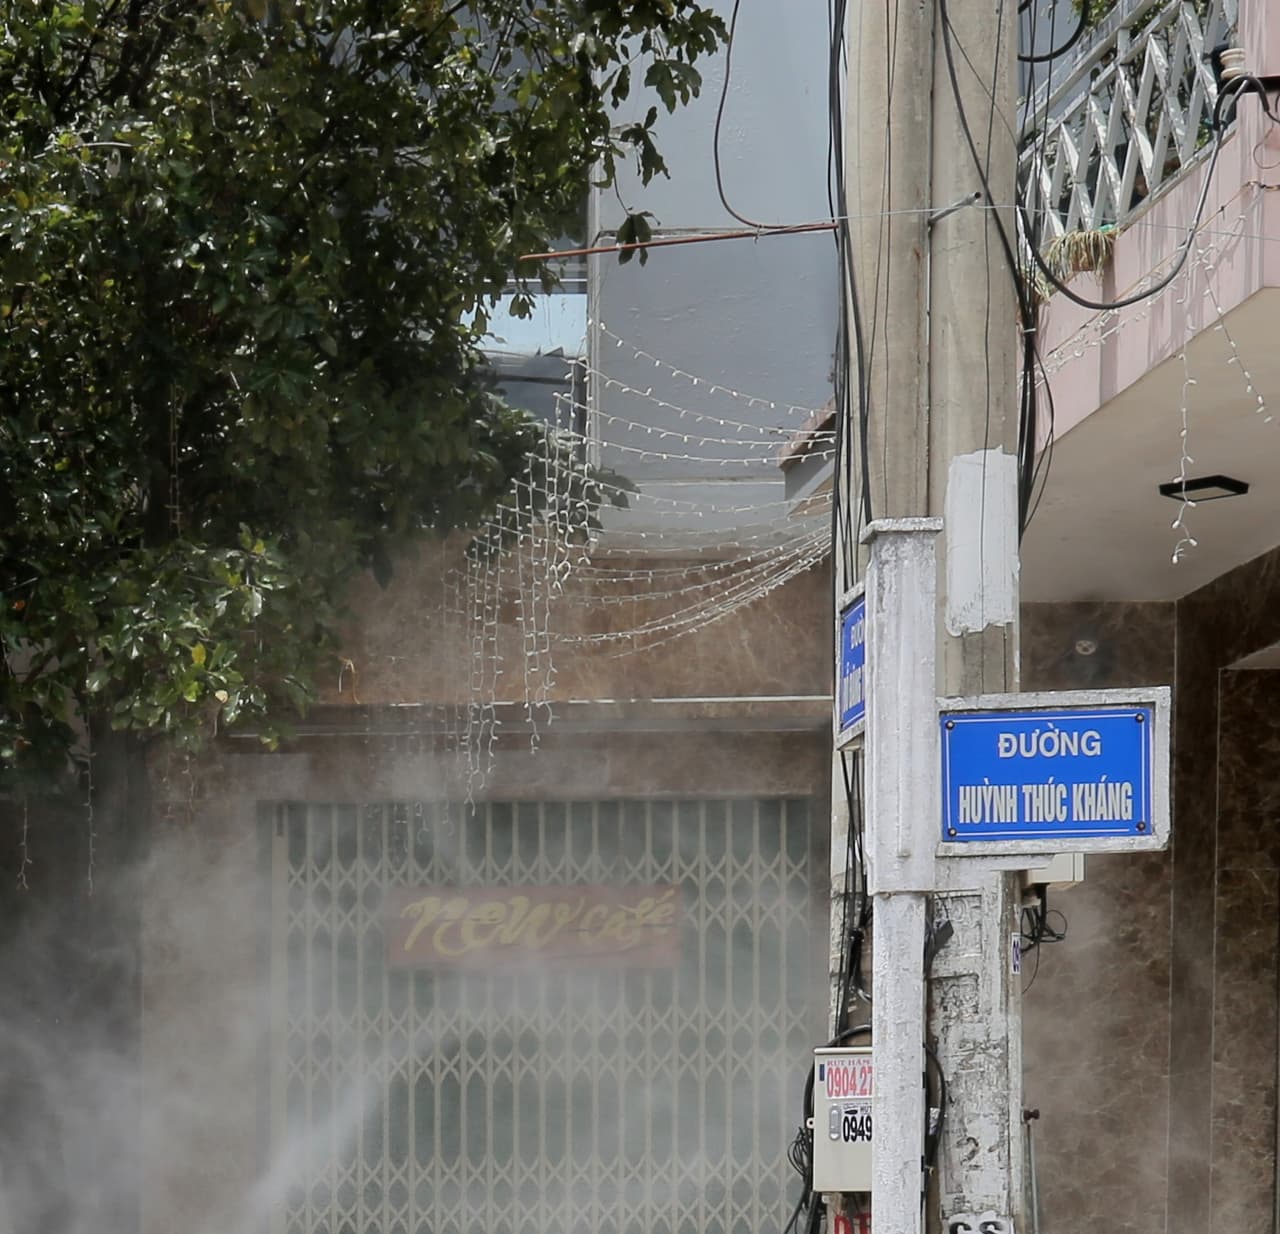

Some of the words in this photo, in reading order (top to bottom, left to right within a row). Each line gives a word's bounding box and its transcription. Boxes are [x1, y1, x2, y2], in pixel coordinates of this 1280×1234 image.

[998, 723, 1101, 758] ĐƯỜNG
[959, 778, 1017, 824] HUỲNH
[1022, 776, 1067, 823] THÚC
[1072, 775, 1132, 821] KHÁNG
